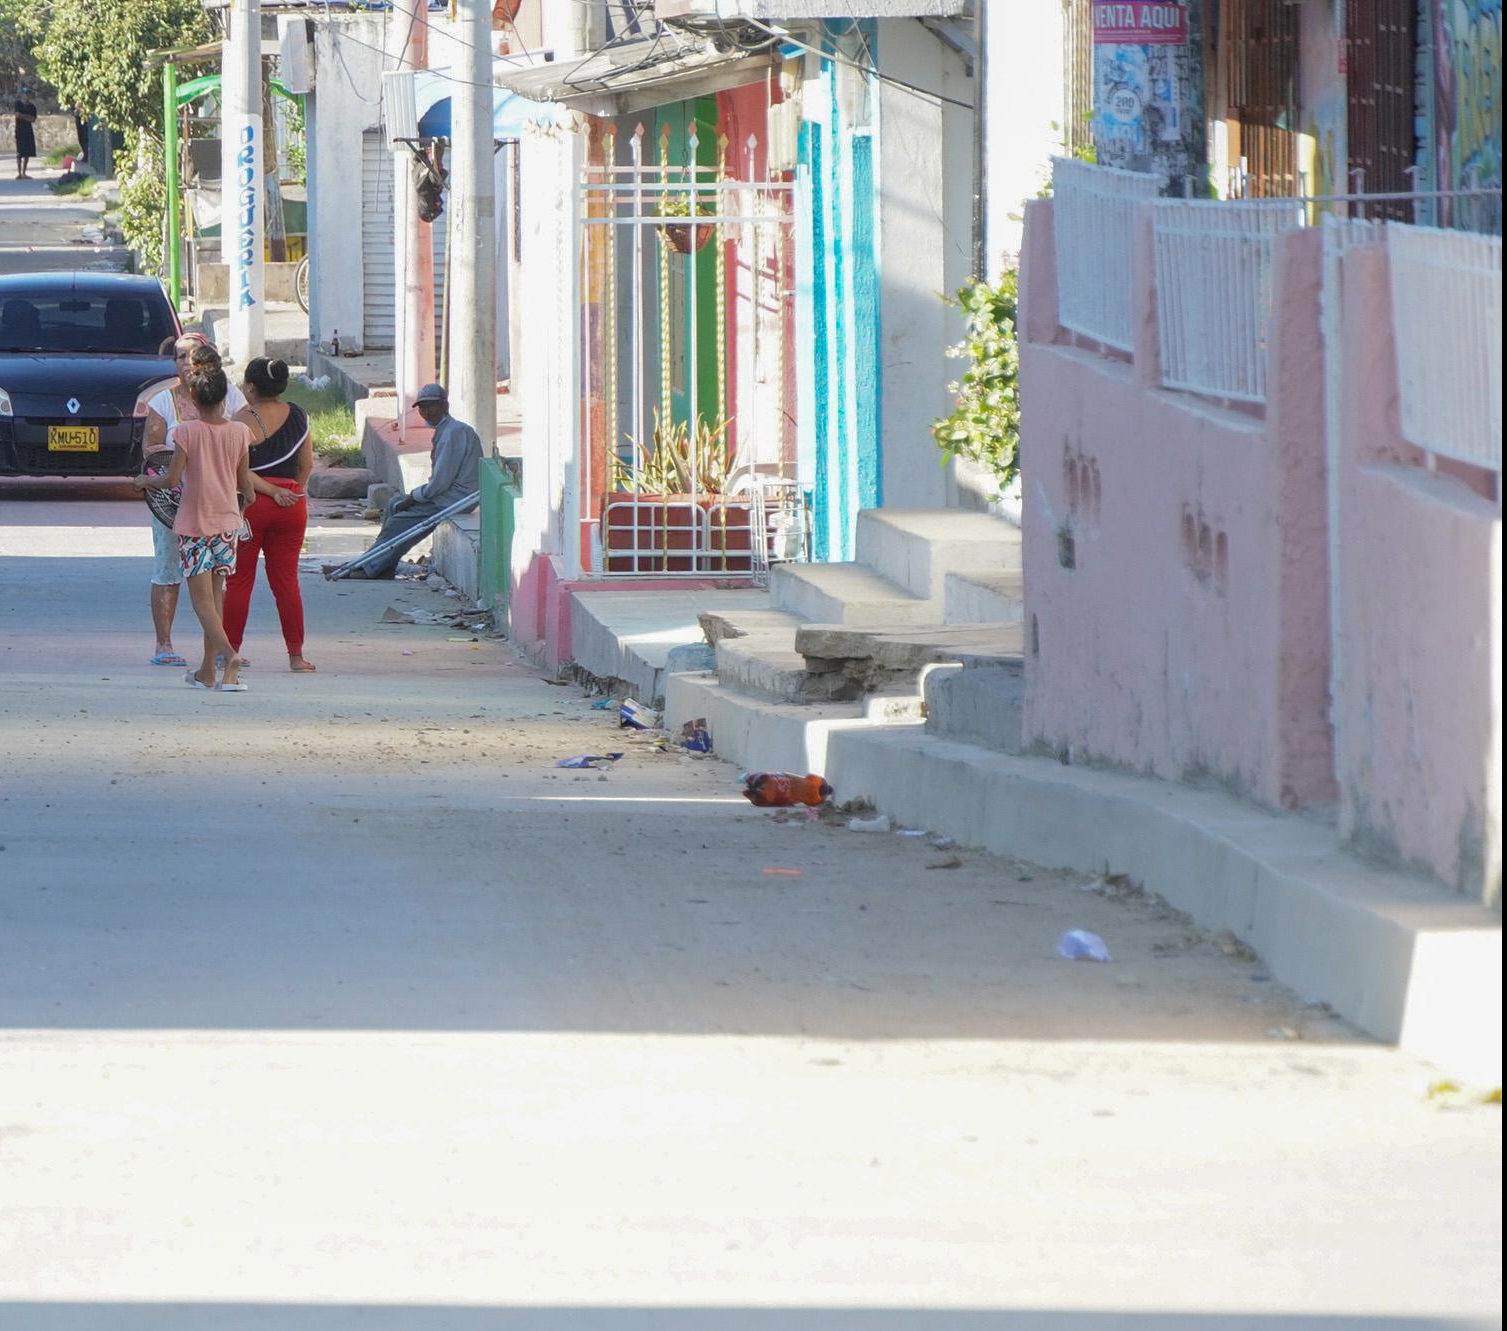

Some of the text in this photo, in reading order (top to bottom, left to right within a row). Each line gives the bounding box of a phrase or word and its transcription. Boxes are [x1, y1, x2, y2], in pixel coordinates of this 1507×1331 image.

[1095, 5, 1135, 28] VENTA
[237, 125, 256, 312] DROGUERIA
[50, 431, 96, 444] KMU-510
